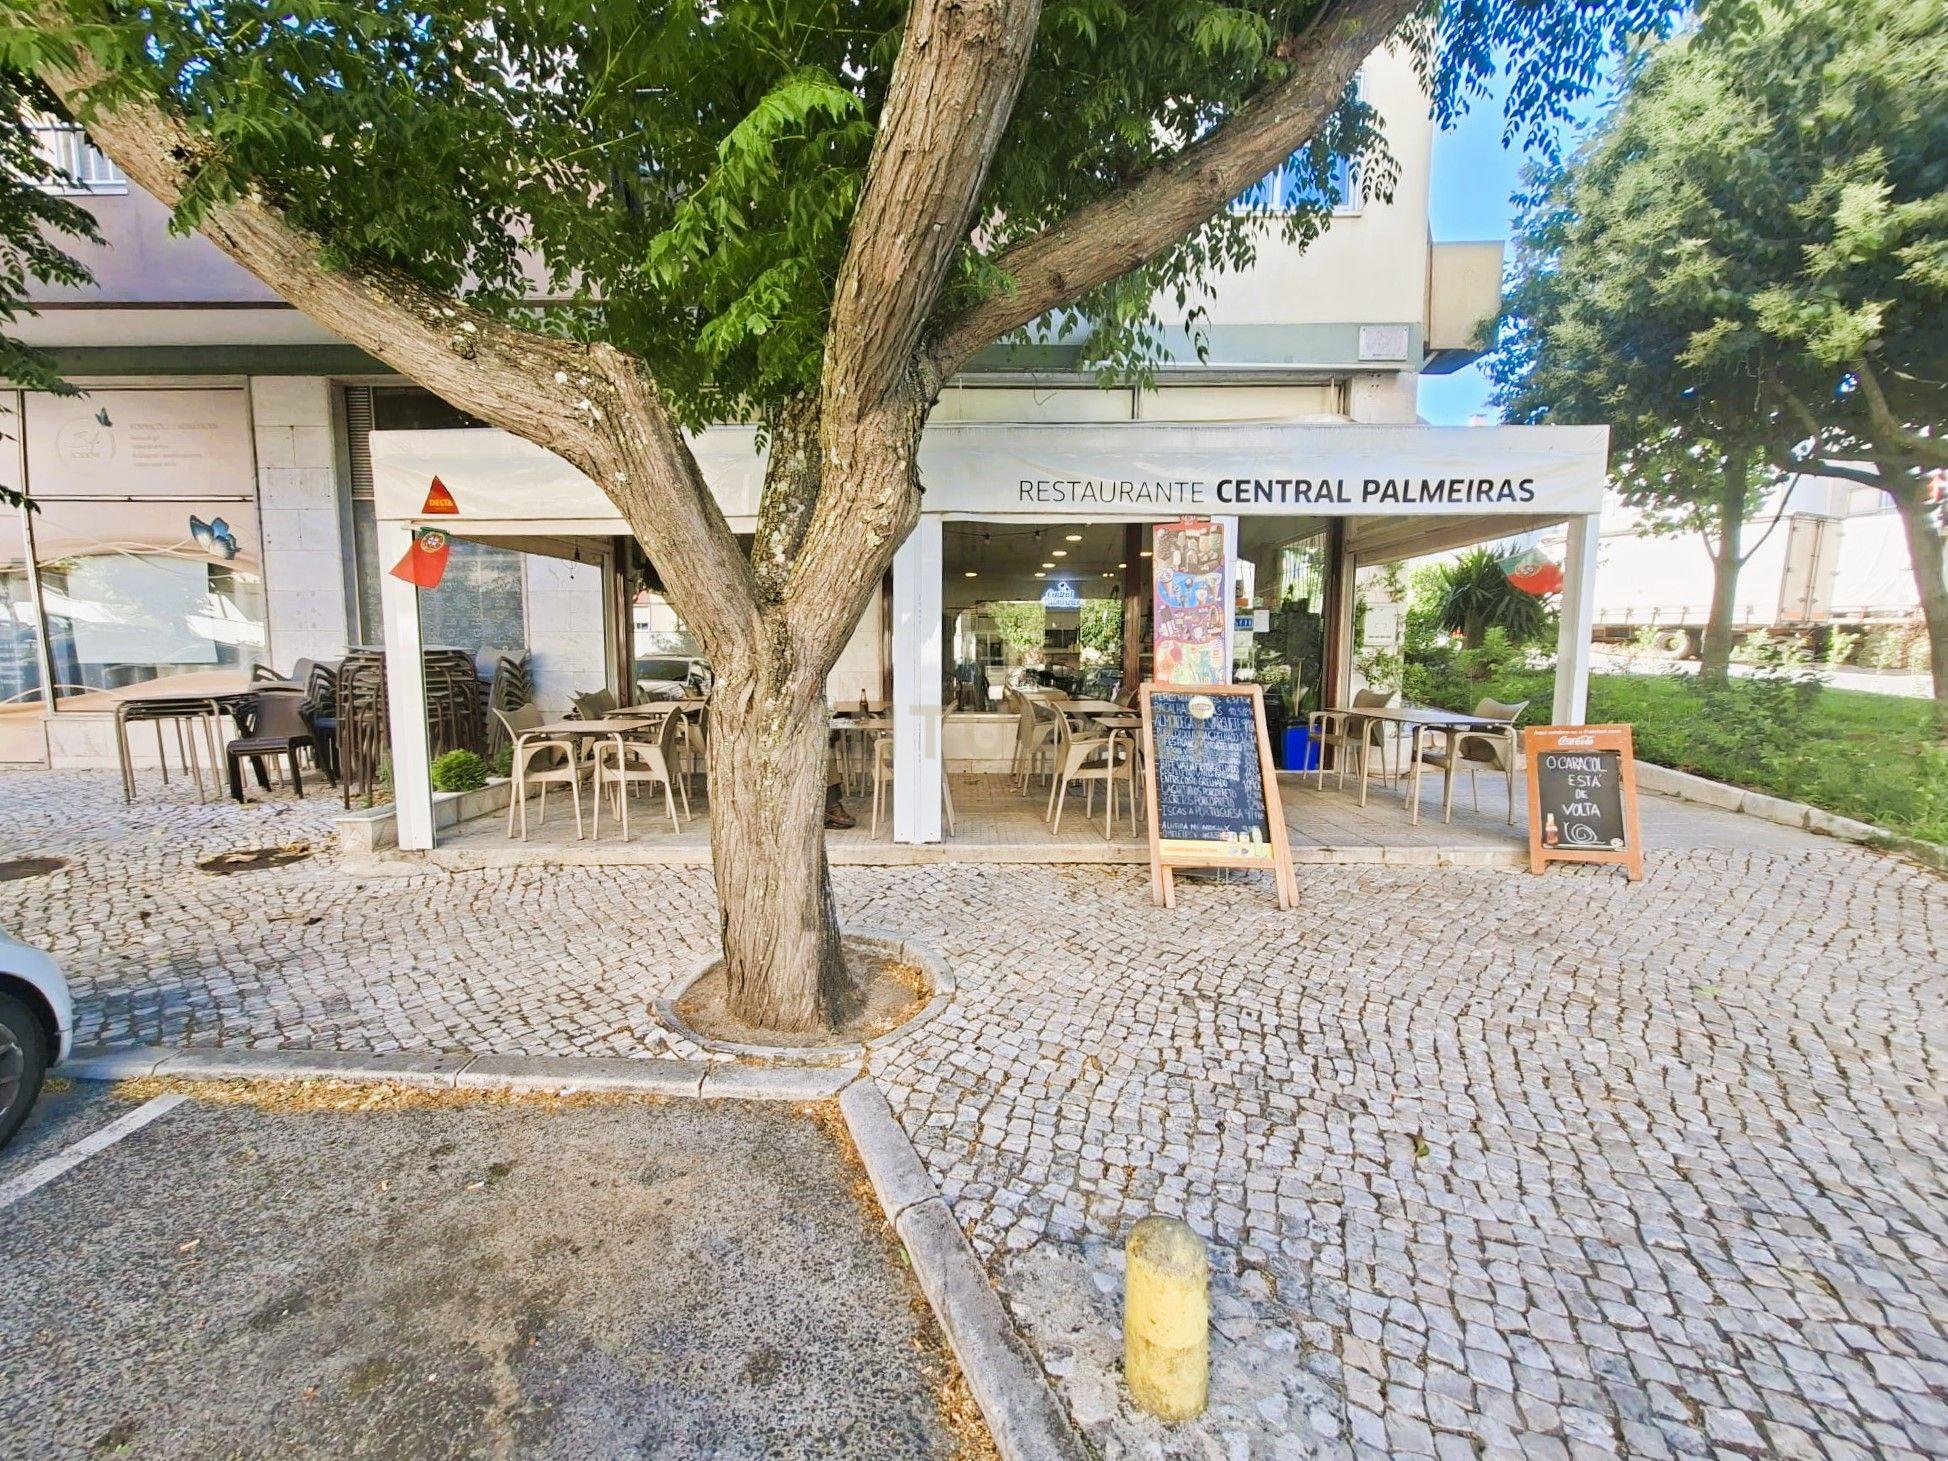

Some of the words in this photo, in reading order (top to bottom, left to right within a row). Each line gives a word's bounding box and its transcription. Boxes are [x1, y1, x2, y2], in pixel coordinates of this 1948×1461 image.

[1019, 480, 1205, 503] RESTAURANTE
[1216, 479, 1352, 503] CENTRAL
[1361, 478, 1536, 503] PALMEIRAS
[1546, 755, 1557, 769] O
[1558, 756, 1607, 773] CARACOL
[1568, 773, 1602, 788] ESTÁ
[1575, 788, 1589, 800] DE
[1161, 804, 1187, 816] ISCAS
[1562, 802, 1602, 818] VOLTA
